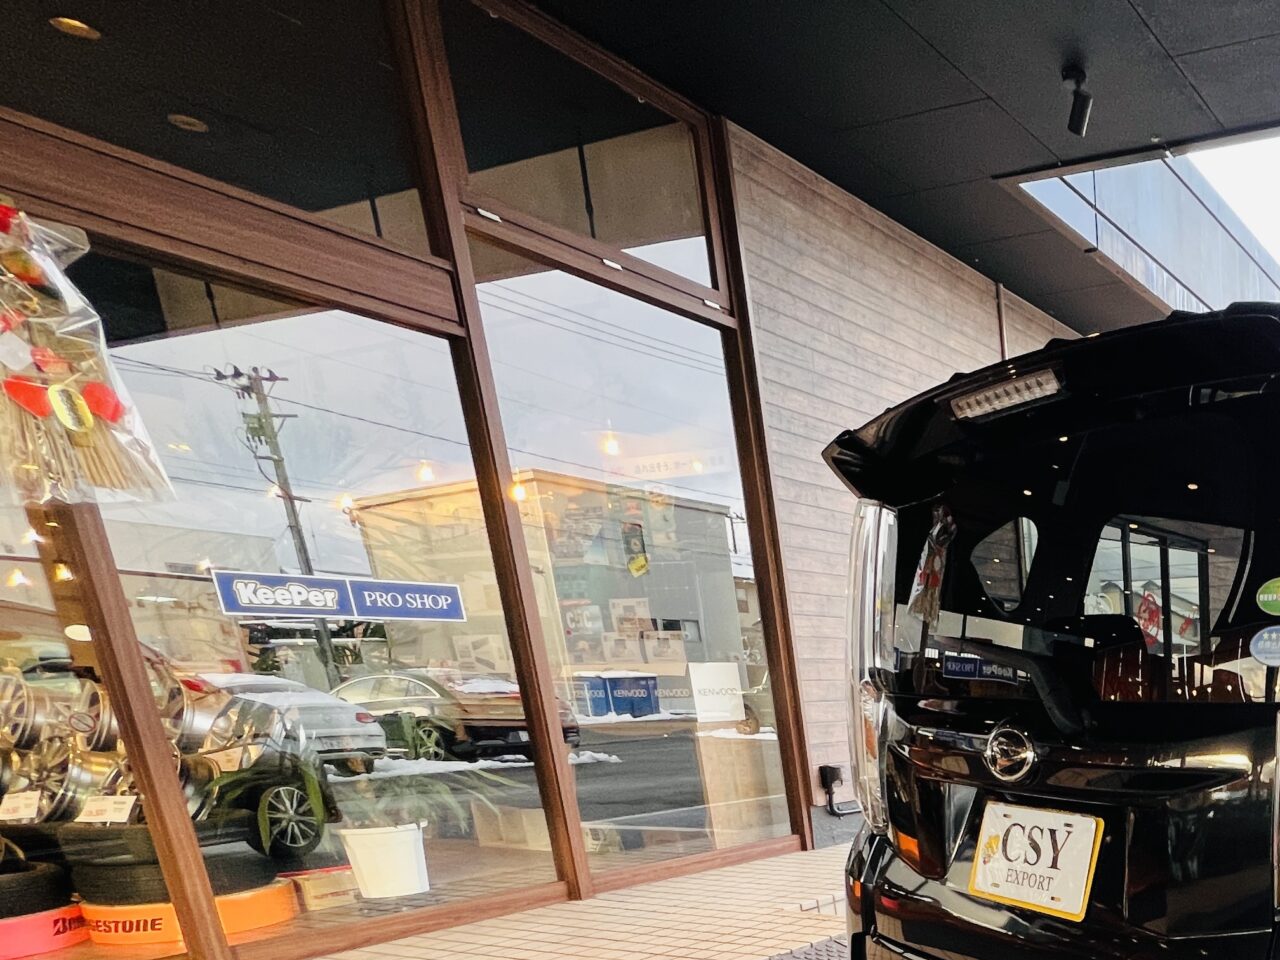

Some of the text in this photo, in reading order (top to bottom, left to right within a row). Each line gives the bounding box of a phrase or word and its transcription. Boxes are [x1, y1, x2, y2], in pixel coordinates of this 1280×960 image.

[234, 580, 452, 610] KeePer PRO SHOP
[613, 688, 648, 698] KENWOOD
[1001, 822, 1074, 871] CSY
[1005, 868, 1054, 892] EXPORT
